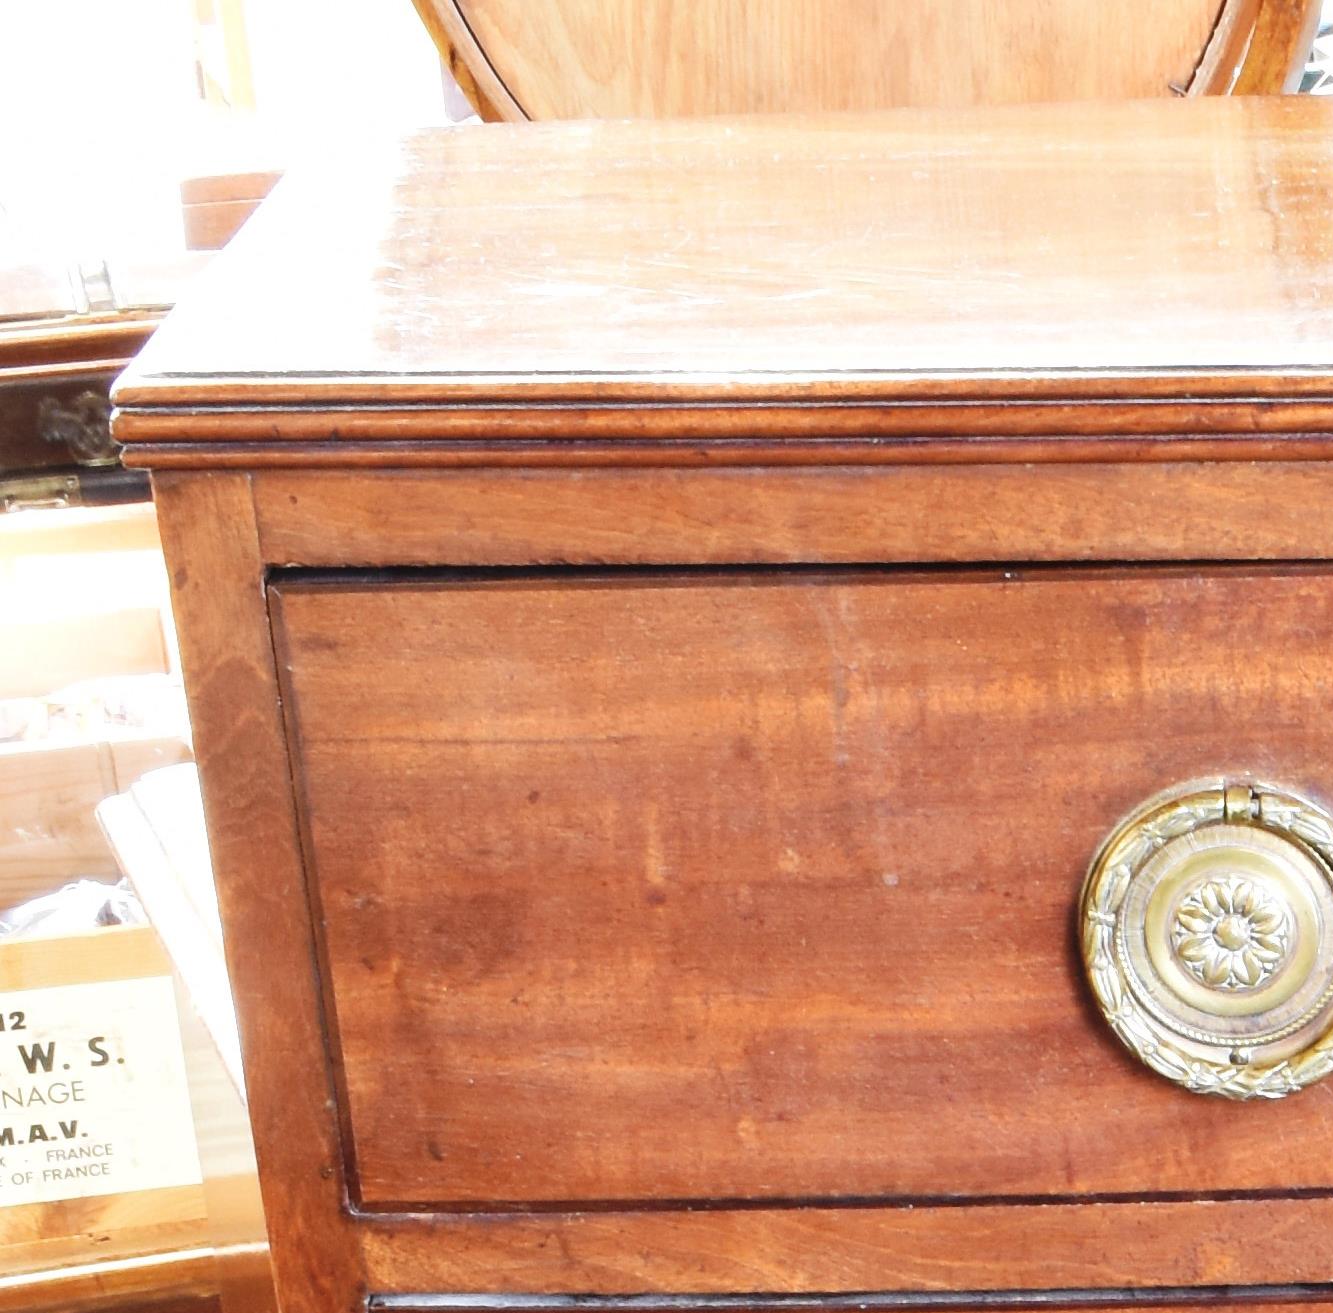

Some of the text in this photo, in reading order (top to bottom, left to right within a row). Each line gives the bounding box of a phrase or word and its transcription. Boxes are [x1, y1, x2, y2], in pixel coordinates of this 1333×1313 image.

[18, 1036, 125, 1074] W. S.
[46, 1143, 113, 1162] FRANCE
[11, 1171, 33, 1185] OF
[42, 1162, 110, 1182] FRANCE
